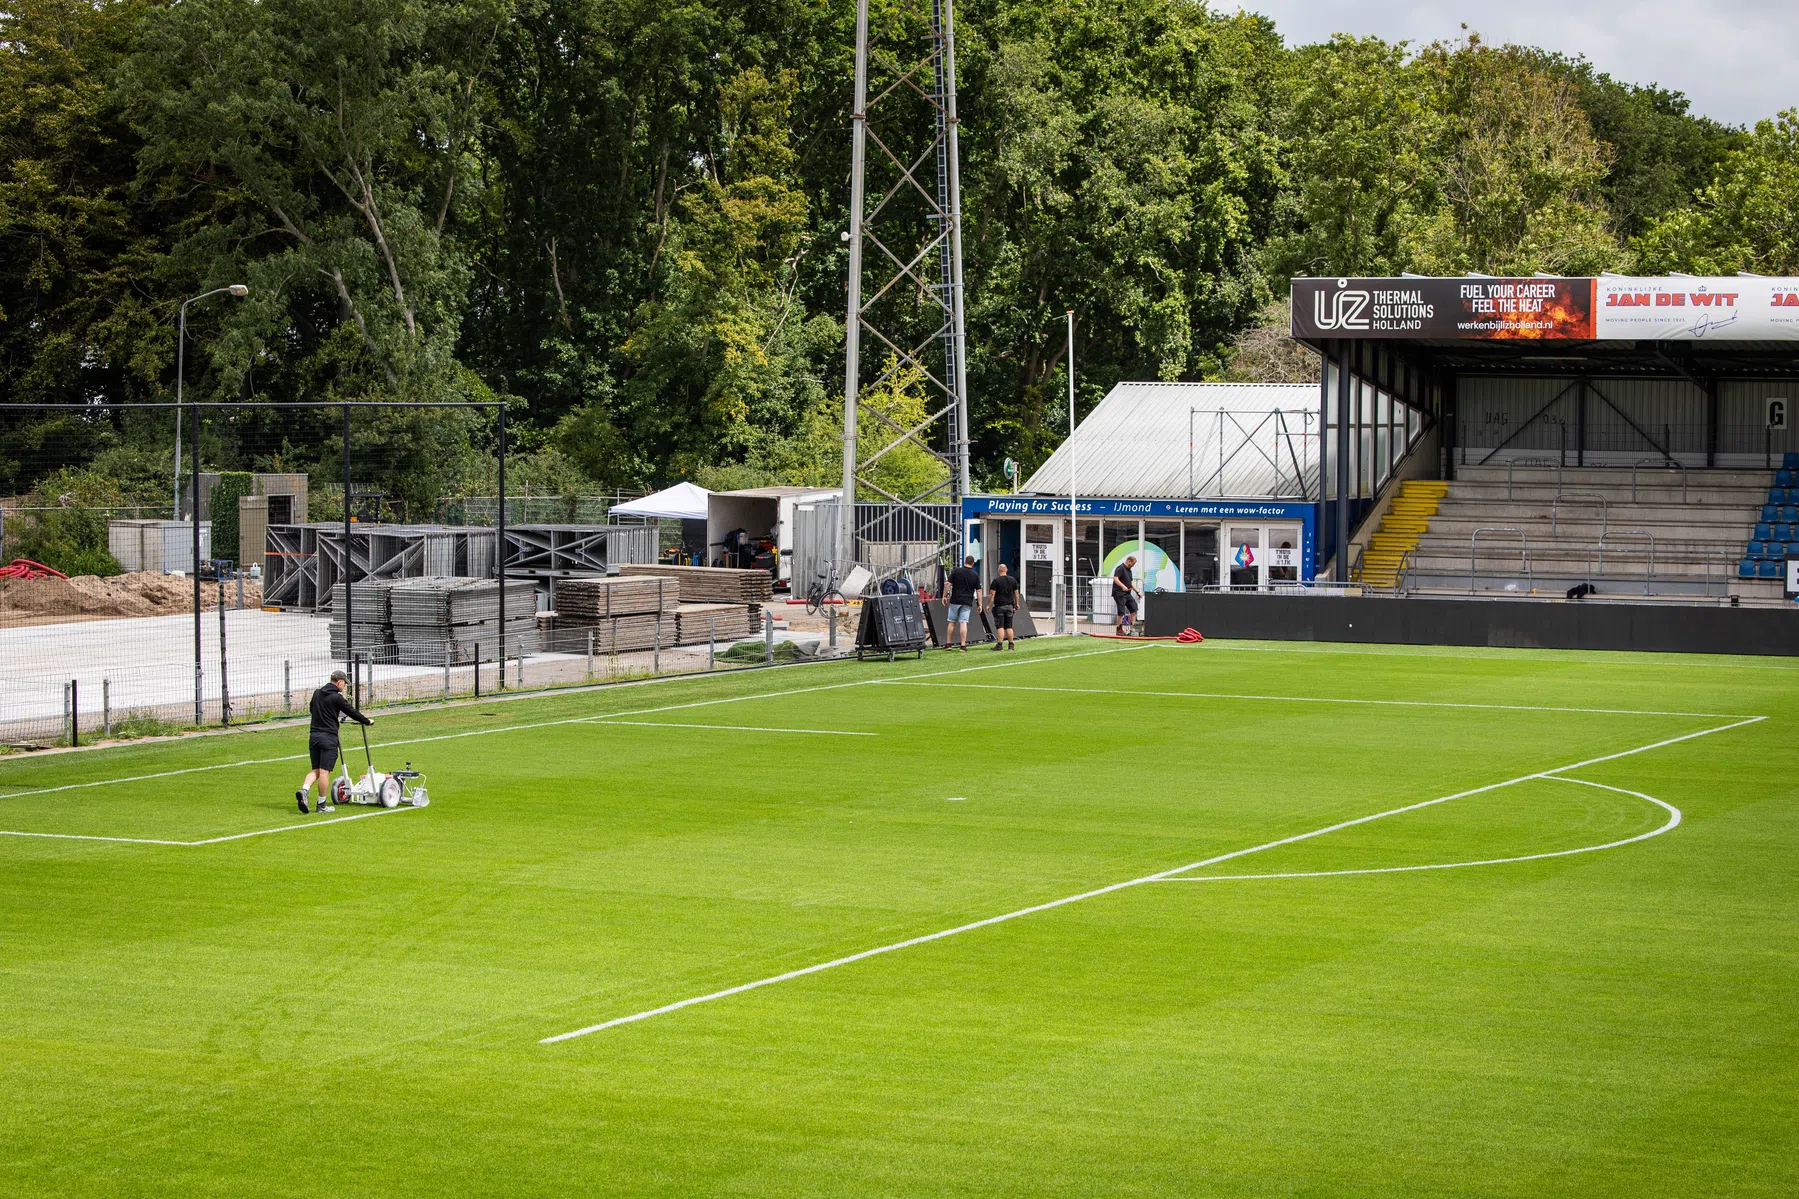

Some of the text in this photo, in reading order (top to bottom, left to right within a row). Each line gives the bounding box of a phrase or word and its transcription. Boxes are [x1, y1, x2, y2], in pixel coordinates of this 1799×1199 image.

[1373, 290, 1424, 304] THERMAL
[1460, 283, 1556, 299] FUEL YOUR CAREER
[1472, 299, 1544, 313] FEEL THE HEAT
[1605, 293, 1739, 307] JAN DE WIT
[1373, 304, 1434, 319] SOLUTIONS
[1373, 319, 1422, 330] HOLLAND
[1457, 320, 1553, 332] werkenbijlizholland.nl
[1769, 401, 1784, 425] G
[988, 500, 1028, 513] Playing
[1032, 500, 1048, 511] for
[1114, 502, 1152, 512] IJmond
[1175, 505, 1286, 515] Leren met een wow-factor
